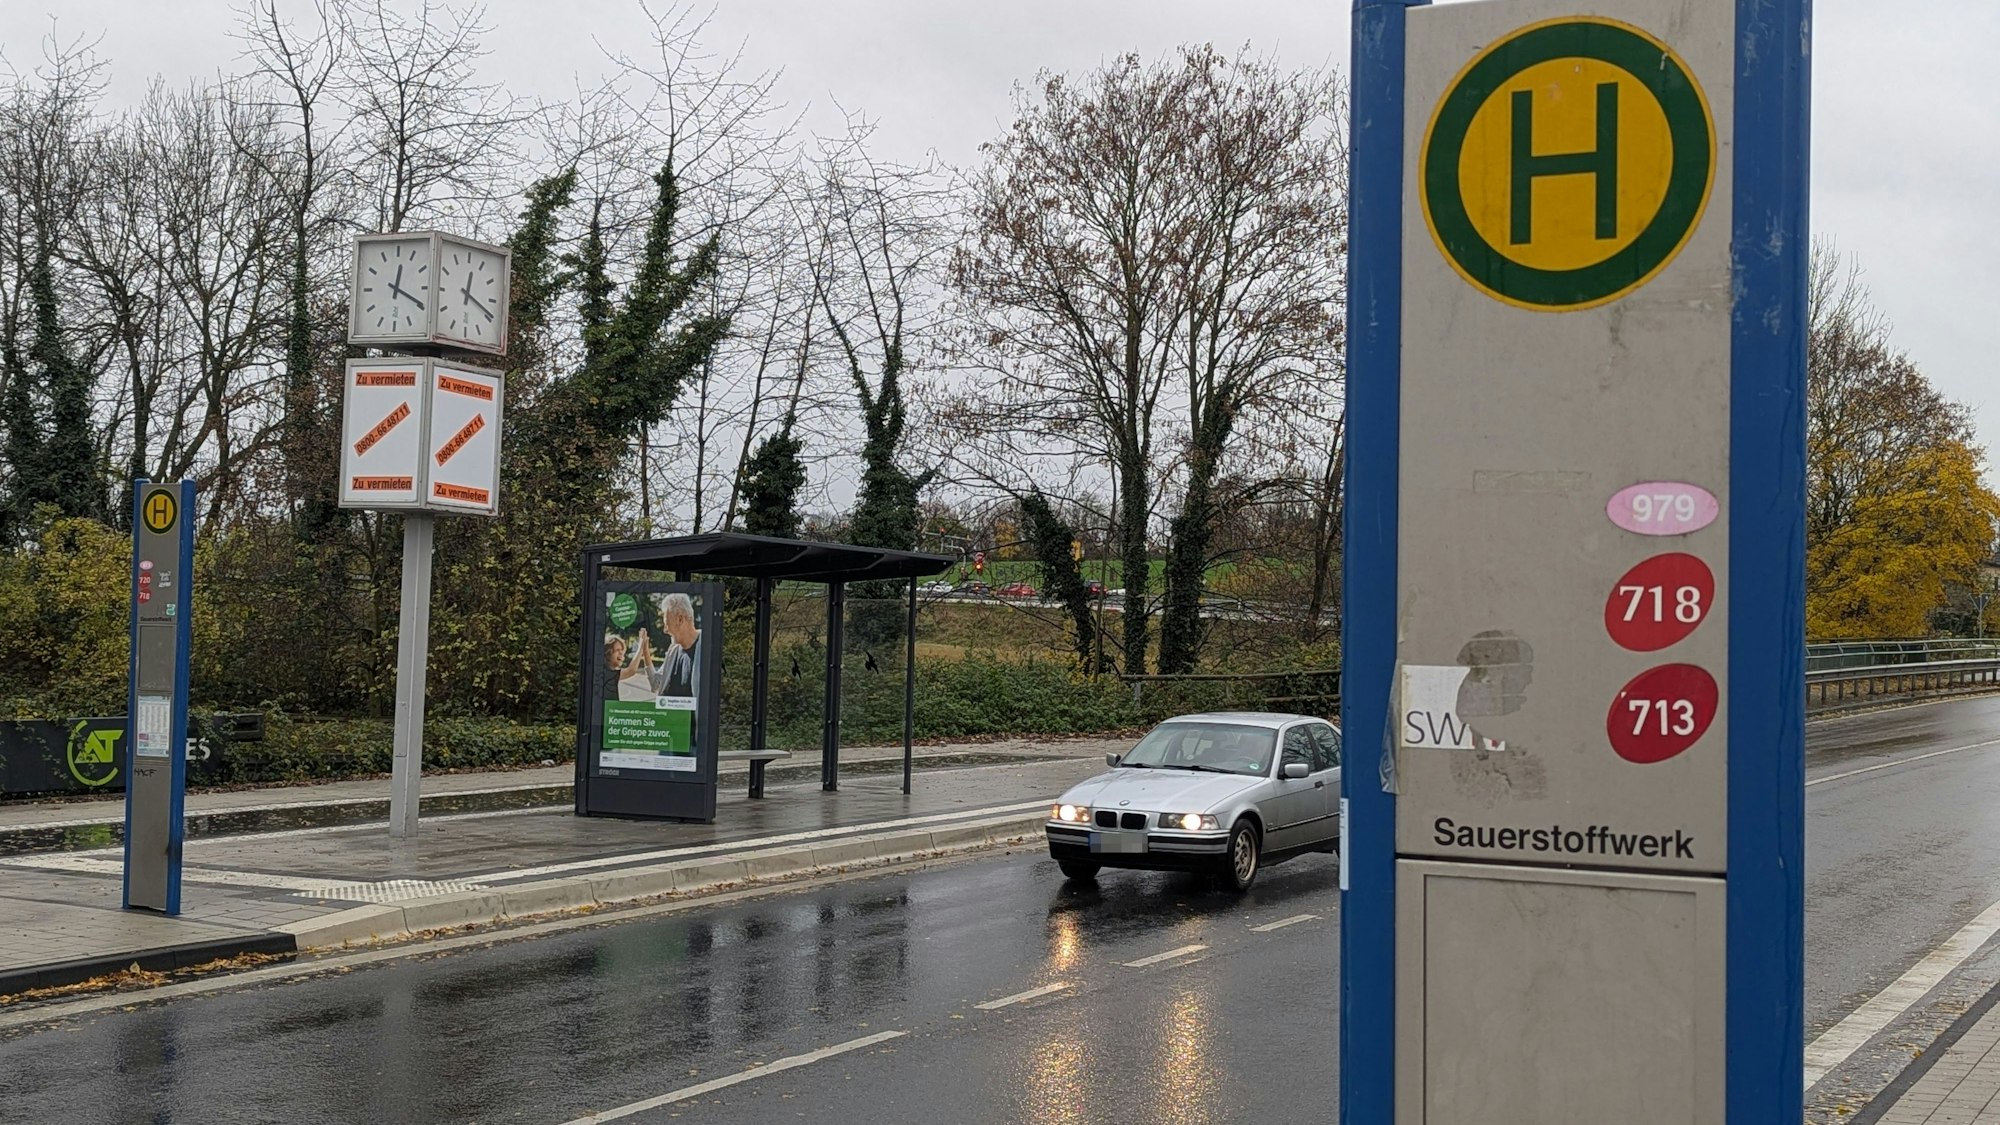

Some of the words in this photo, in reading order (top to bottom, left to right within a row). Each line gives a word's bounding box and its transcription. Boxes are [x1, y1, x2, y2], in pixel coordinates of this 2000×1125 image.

[1510, 82, 1619, 246] H
[356, 374, 368, 385] Zu
[370, 373, 416, 385] vermieten
[440, 378, 451, 390] Zu
[452, 382, 492, 398] vermieten
[352, 479, 364, 489] Zu
[367, 478, 412, 489] vermieten
[436, 484, 447, 496] Zu
[448, 486, 487, 502] vermieten
[153, 498, 168, 525] H
[1632, 494, 1695, 523] 979
[139, 576, 151, 584] 720
[1619, 585, 1701, 624] 718
[608, 716, 642, 726] Kommen
[642, 717, 656, 727] Sie
[1628, 699, 1695, 736] 713
[607, 727, 621, 736] der
[621, 727, 647, 738] Grippe
[647, 730, 671, 738] zuvor.
[184, 736, 211, 761] ES
[1433, 817, 1695, 859] Sauerstoffwerk
